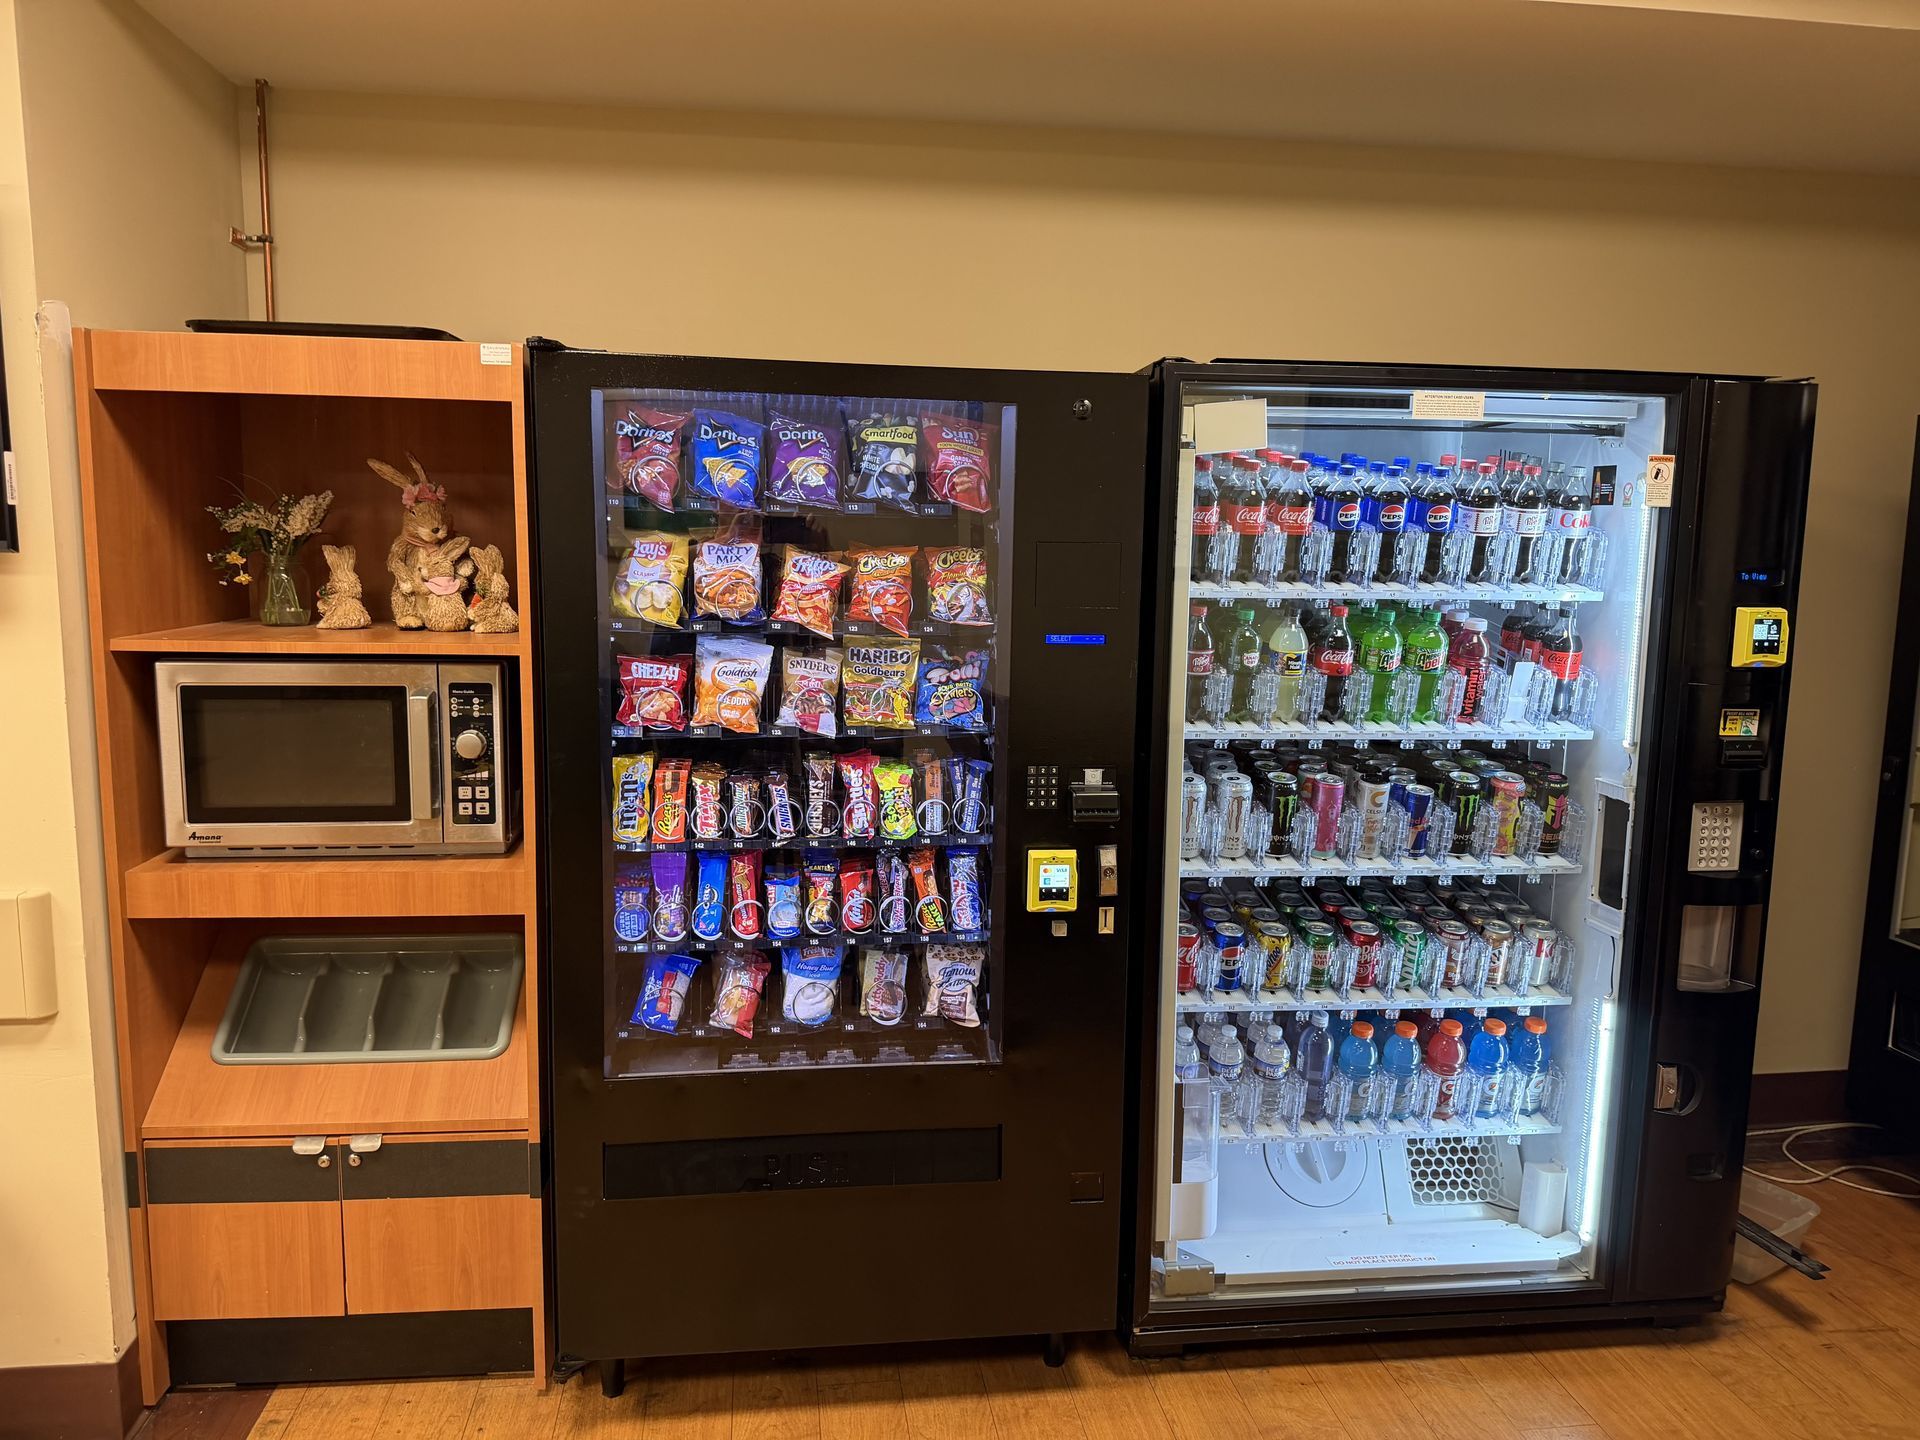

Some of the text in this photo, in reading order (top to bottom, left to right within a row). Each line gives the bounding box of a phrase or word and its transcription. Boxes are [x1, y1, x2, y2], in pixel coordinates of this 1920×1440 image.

[615, 420, 675, 444] Doritos
[701, 424, 756, 447] Doritos
[864, 428, 915, 441] Smartfood
[941, 426, 975, 441] Sun
[862, 454, 881, 464] WHITE
[633, 538, 668, 560] Lay's
[707, 544, 753, 555] PARTY
[716, 554, 743, 564] MIX
[858, 554, 908, 572] Cheetos
[937, 549, 984, 568] Cheetos
[1741, 572, 1768, 580] To View
[849, 647, 912, 665] HARIBO
[716, 664, 758, 678] Goldfish
[854, 665, 906, 677] Goldbears
[926, 660, 981, 684] Trolli
[1464, 668, 1480, 715] vitamin
[1475, 671, 1487, 700] water
[657, 792, 674, 834] Reese's
[697, 786, 718, 833] Twix
[188, 831, 222, 841] Amana
[797, 961, 834, 973] Honey Bun
[1220, 958, 1242, 967] PEP
[1401, 933, 1417, 989] Sprite
[873, 956, 889, 985] Buddy
[938, 965, 977, 979] Famous
